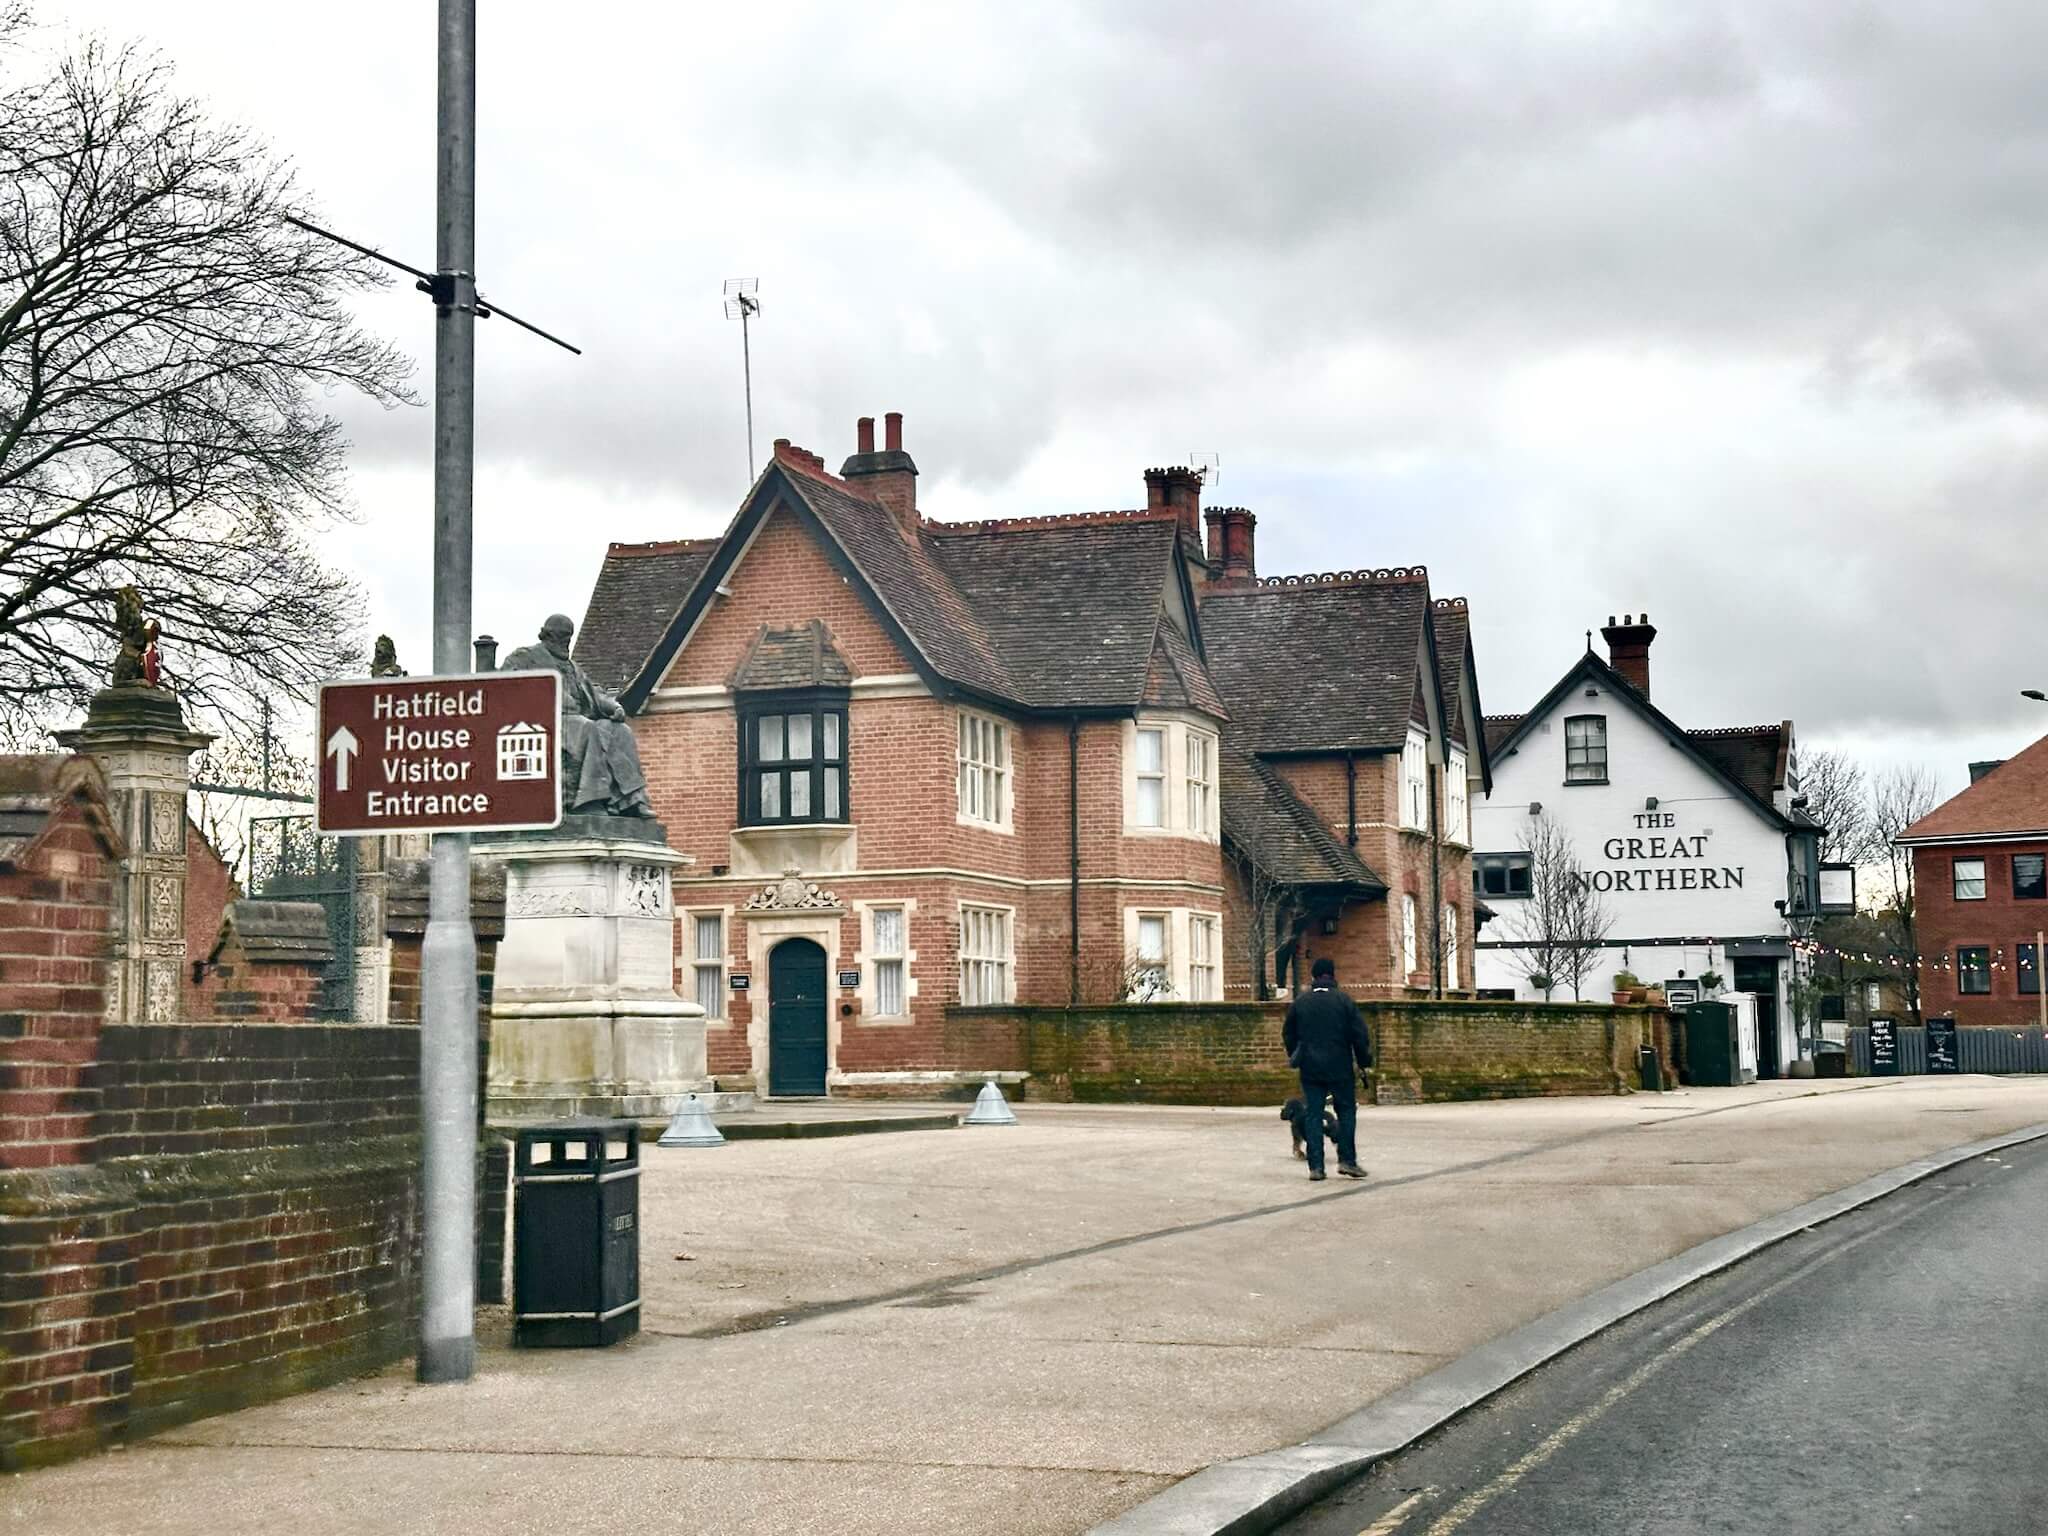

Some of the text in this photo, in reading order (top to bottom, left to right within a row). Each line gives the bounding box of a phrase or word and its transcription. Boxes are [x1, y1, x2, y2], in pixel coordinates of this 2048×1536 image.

[374, 690, 483, 719] Hatfield
[385, 725, 470, 750] House
[382, 757, 471, 783] Visitor
[367, 791, 489, 816] Entrance
[1633, 813, 1675, 829] THE
[1604, 836, 1708, 860] GREAT
[1570, 867, 1744, 892] NORTHERN
